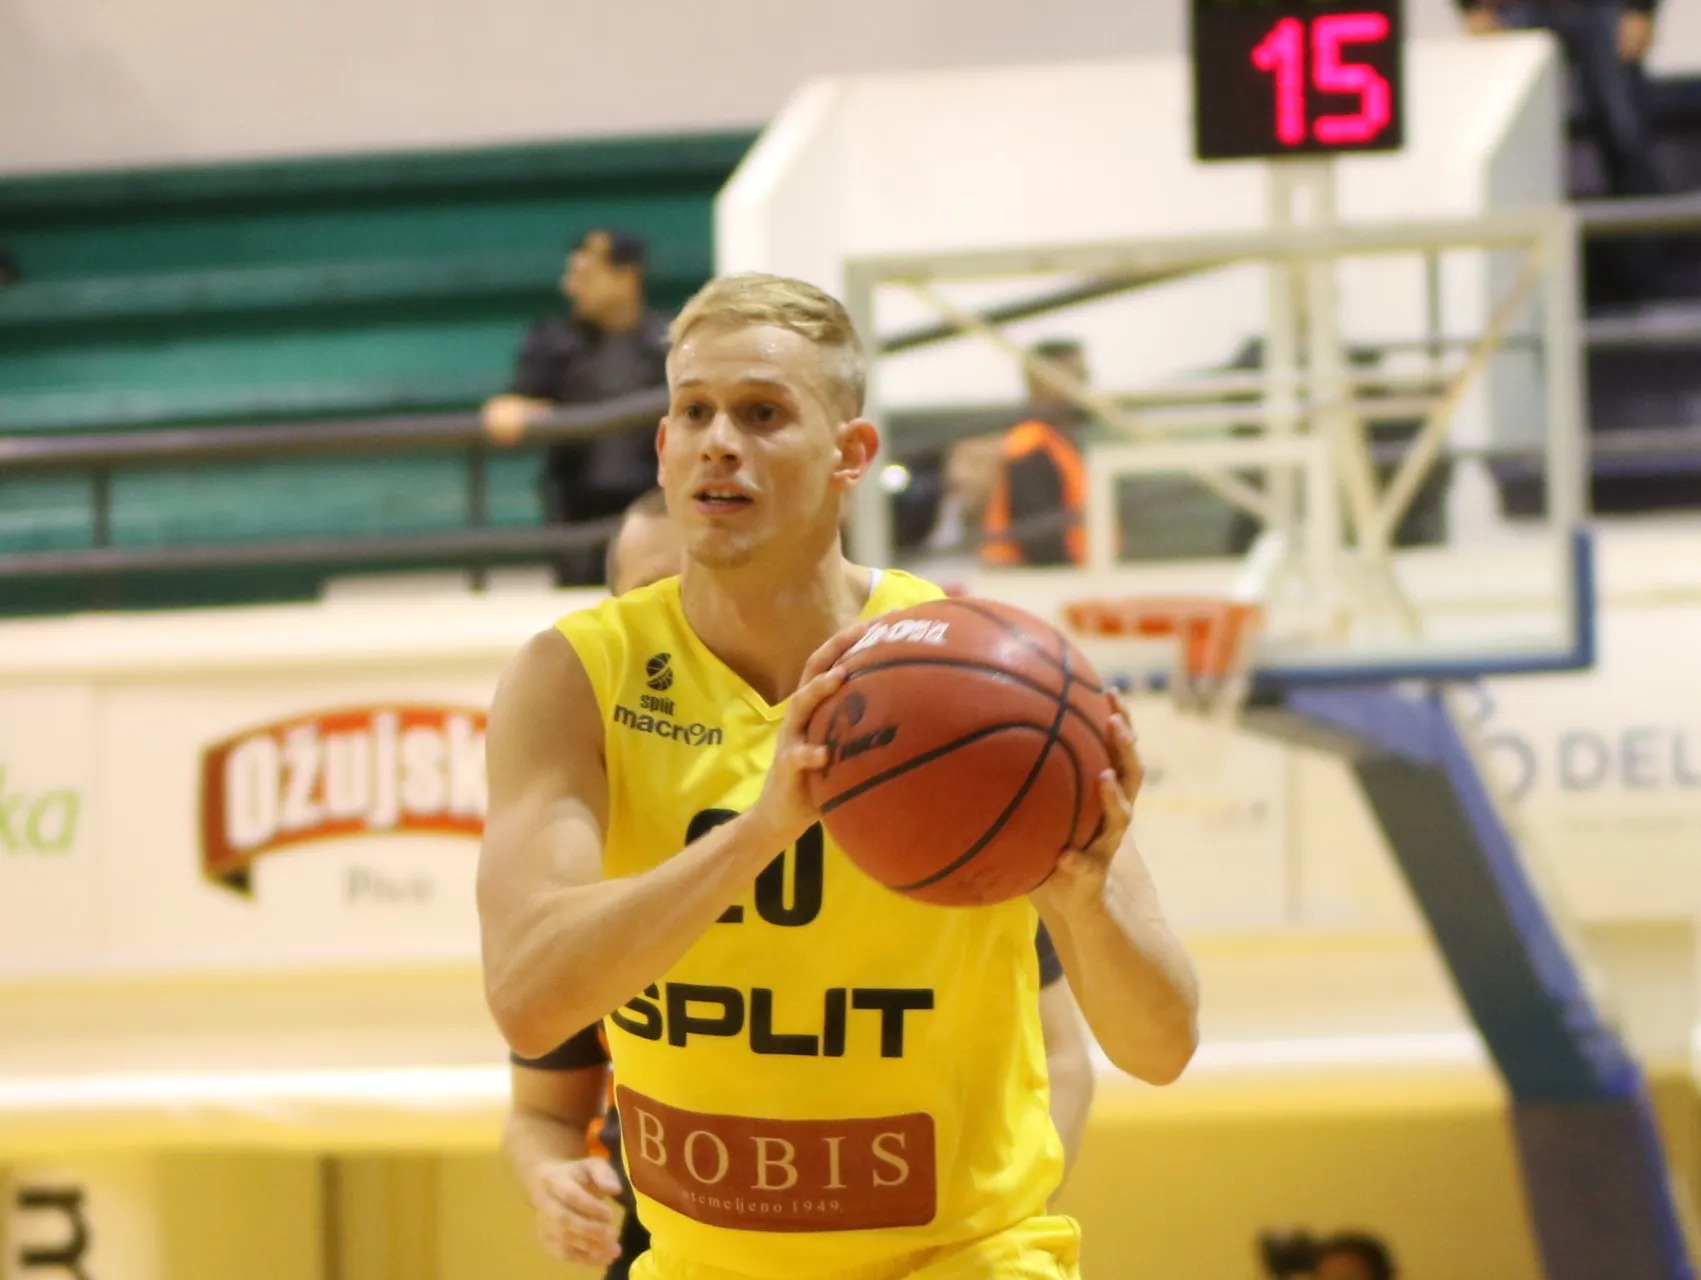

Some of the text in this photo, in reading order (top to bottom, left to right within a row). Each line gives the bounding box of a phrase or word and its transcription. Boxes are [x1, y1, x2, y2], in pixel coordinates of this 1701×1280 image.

[1251, 12, 1391, 146] 15
[613, 704, 723, 747] macron
[640, 694, 676, 717] split
[610, 982, 935, 1059] SPLIT
[634, 1107, 911, 1191] BOBIS
